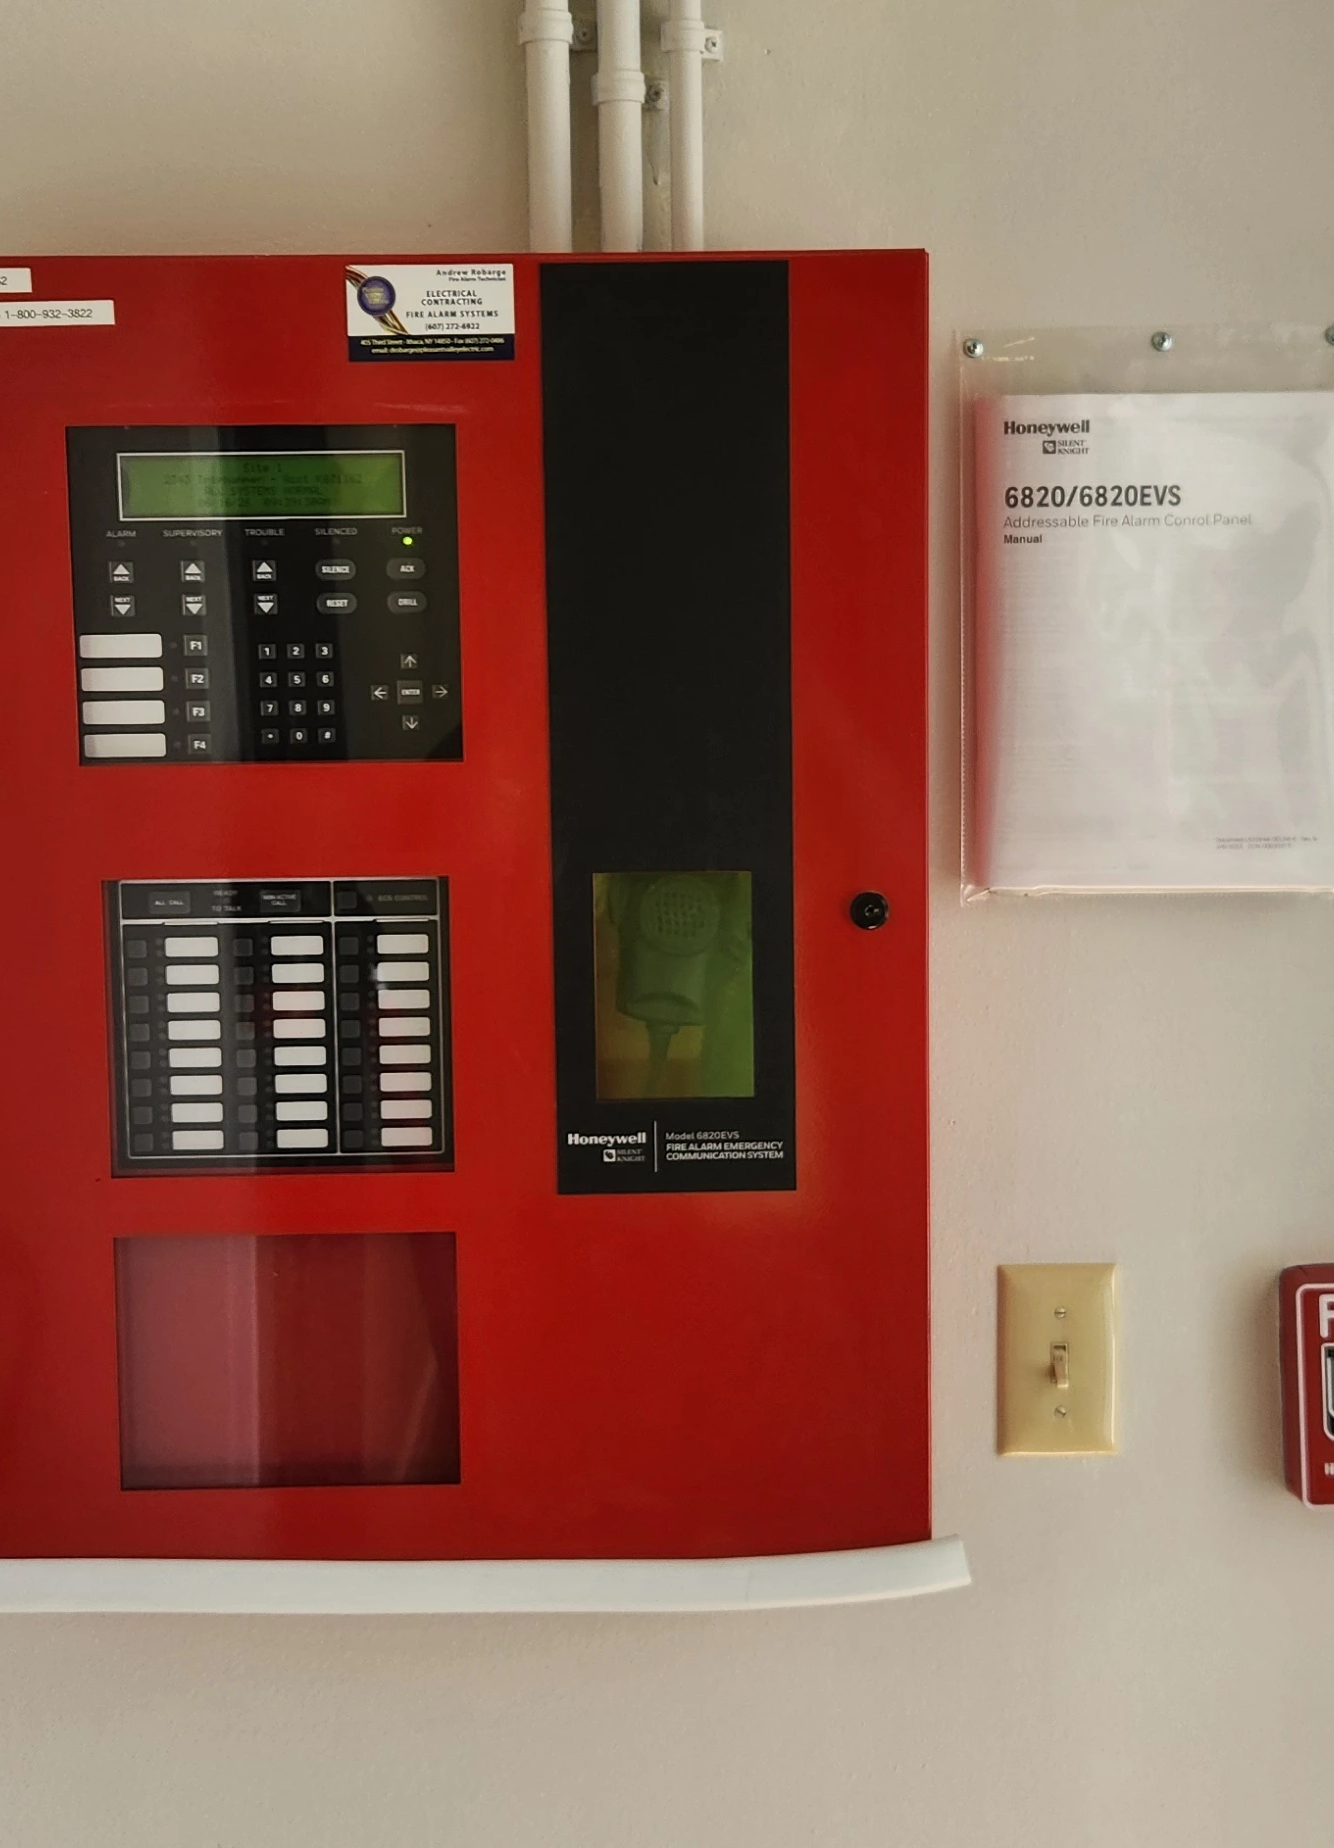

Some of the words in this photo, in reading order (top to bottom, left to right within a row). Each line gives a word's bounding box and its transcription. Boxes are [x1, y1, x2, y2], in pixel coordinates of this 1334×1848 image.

[471, 269, 507, 278] Robarge
[426, 290, 478, 298] ELECTRICAL
[421, 298, 483, 306] CONTRACTING
[5, 309, 93, 319] 1-800-932-3822
[425, 323, 445, 331] (607)
[1003, 420, 1090, 436] Honeywell
[1057, 447, 1089, 455] KNIGHT
[1004, 485, 1181, 508] 6820/6820EVS
[1003, 515, 1089, 528] Addressable
[1093, 514, 1118, 527] Fire
[1121, 514, 1160, 527] Alarm
[1164, 513, 1210, 526] Conrol
[1213, 513, 1252, 526] Panel
[162, 529, 223, 537] SUPERVISORY
[244, 528, 285, 536] TROUBLE
[315, 527, 358, 536] SILENCED
[391, 527, 423, 535] POWER
[1003, 534, 1043, 544] Manual
[190, 641, 202, 650] F1
[264, 647, 270, 655] 1
[292, 647, 300, 655] 2
[321, 647, 329, 656] 3
[191, 674, 204, 684] F2
[265, 676, 273, 684] 4
[293, 675, 301, 684] 5
[322, 675, 329, 684] 6
[192, 707, 205, 716] F3
[267, 704, 273, 713] 7
[294, 703, 302, 712] 8
[323, 703, 330, 712] 9
[296, 731, 303, 741] 0
[194, 740, 206, 750] F4
[567, 1132, 647, 1147] Honeywell
[666, 1131, 695, 1140] Model
[697, 1131, 740, 1140] 6820EVS
[666, 1142, 688, 1151] FIRE
[688, 1142, 722, 1150] ALARM
[723, 1141, 783, 1150] EMERGENCY
[666, 1151, 747, 1161] COMMUNICATION
[747, 1151, 784, 1159] SYSTEM
